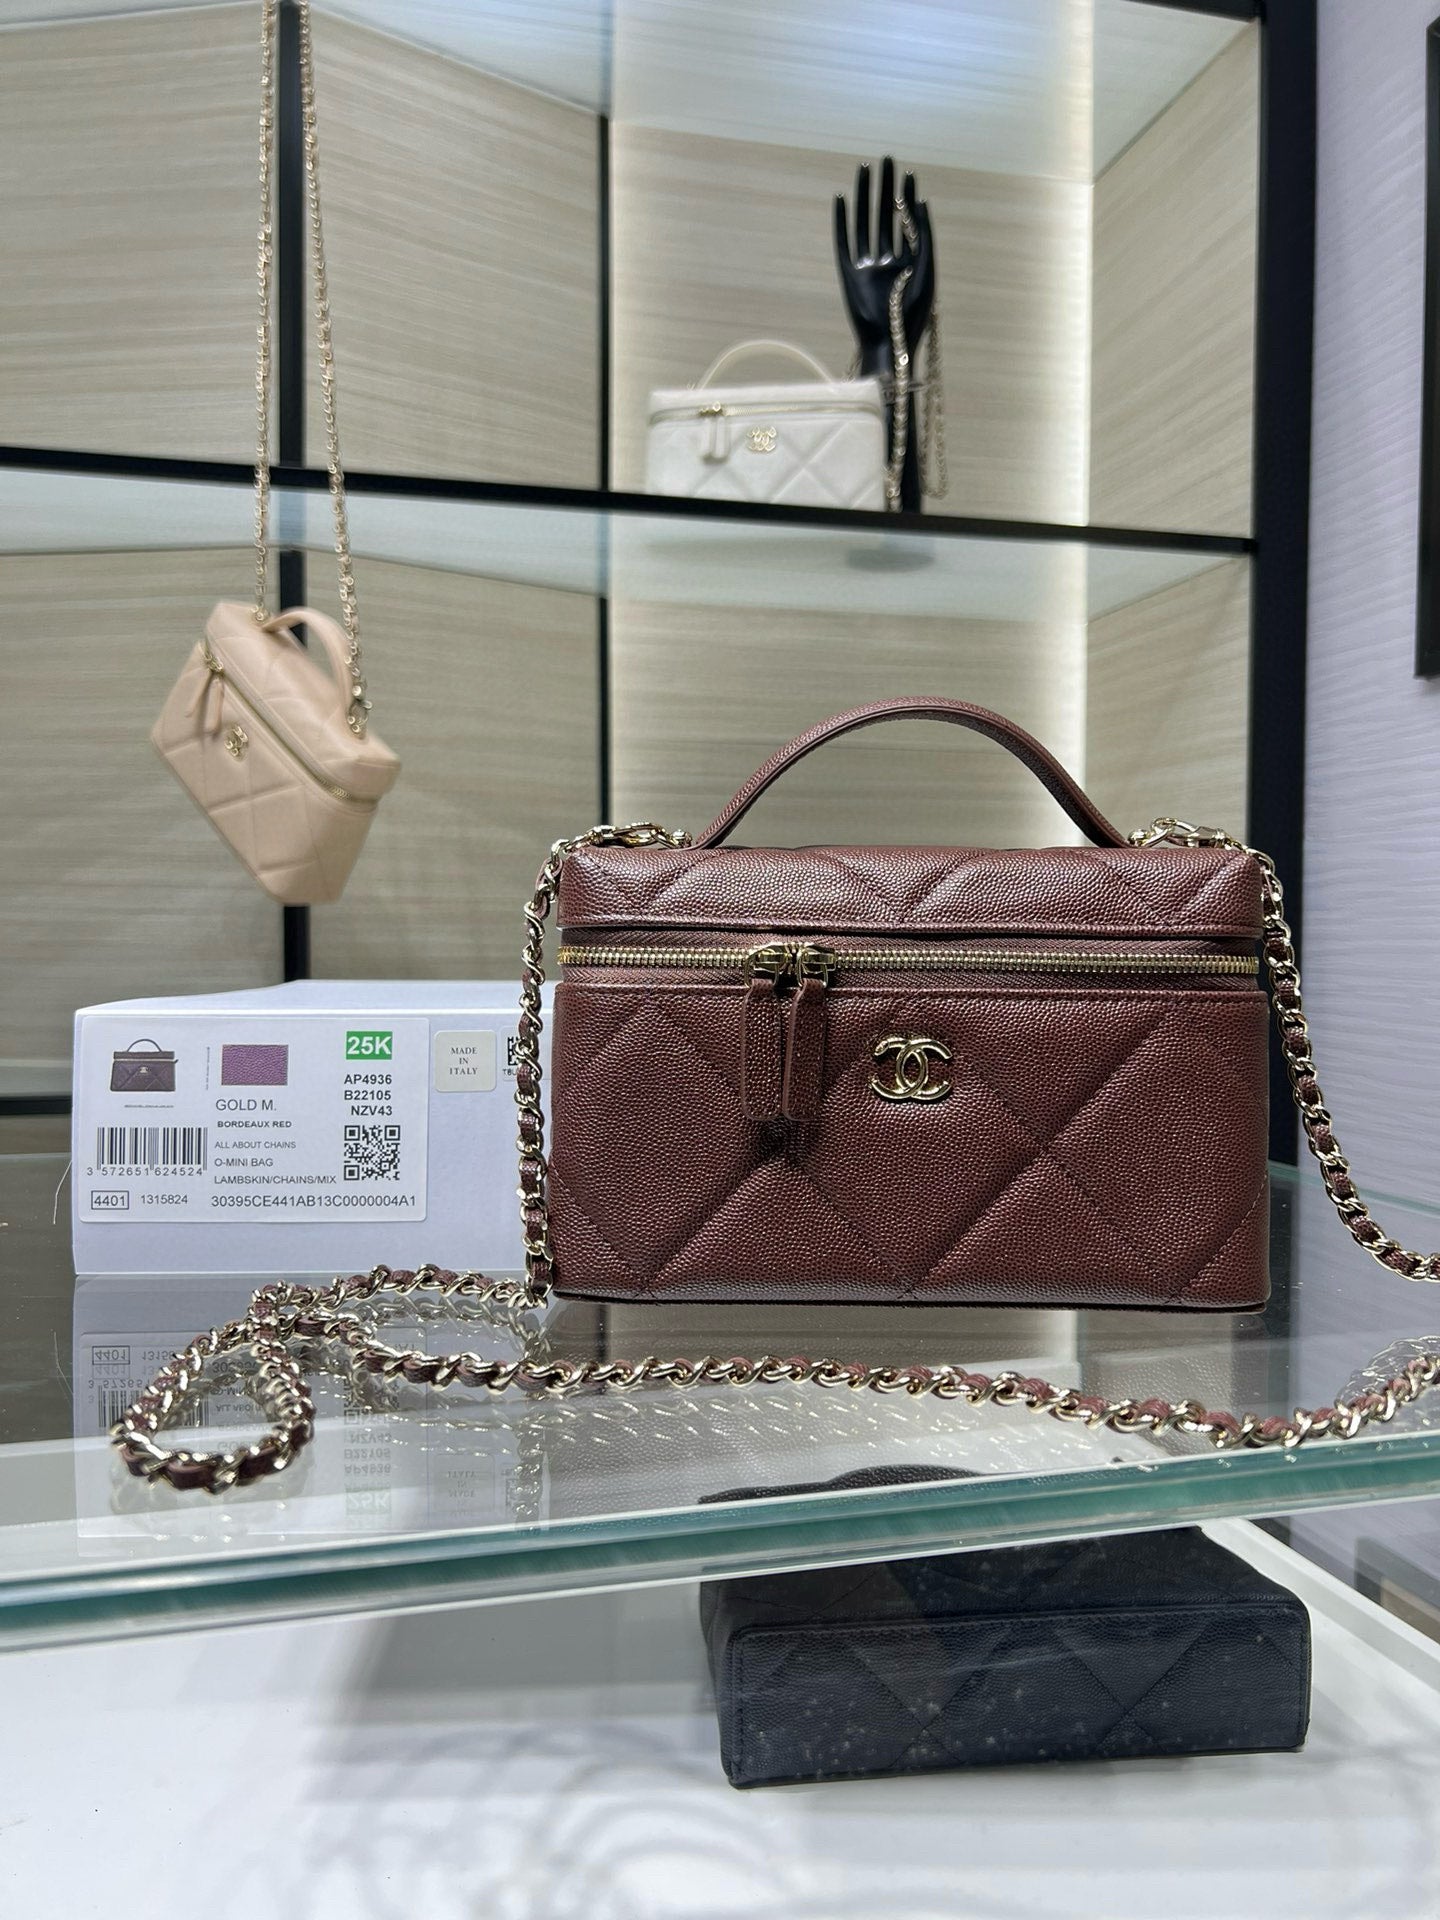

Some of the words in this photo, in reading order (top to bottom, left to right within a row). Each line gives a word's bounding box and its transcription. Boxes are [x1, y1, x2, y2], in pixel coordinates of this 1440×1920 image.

[347, 1036, 392, 1055] 25K
[450, 1047, 478, 1055] MADE
[459, 1057, 469, 1065] IN
[449, 1067, 478, 1075] ITALY
[344, 1073, 392, 1085] AP4936
[344, 1090, 391, 1101] B22105
[215, 1099, 257, 1111] GOLD
[261, 1099, 277, 1111] M.
[351, 1105, 393, 1116] NZV43
[214, 1141, 230, 1149] ALL
[232, 1141, 261, 1149] ABOUT
[263, 1141, 297, 1149] CHAINS
[214, 1158, 248, 1167] O-MINI
[251, 1158, 274, 1167] BAG
[214, 1175, 337, 1185] LAMBSKIN/CHAINS/MIX
[94, 1195, 126, 1207] 4401
[141, 1194, 188, 1205] 1315824
